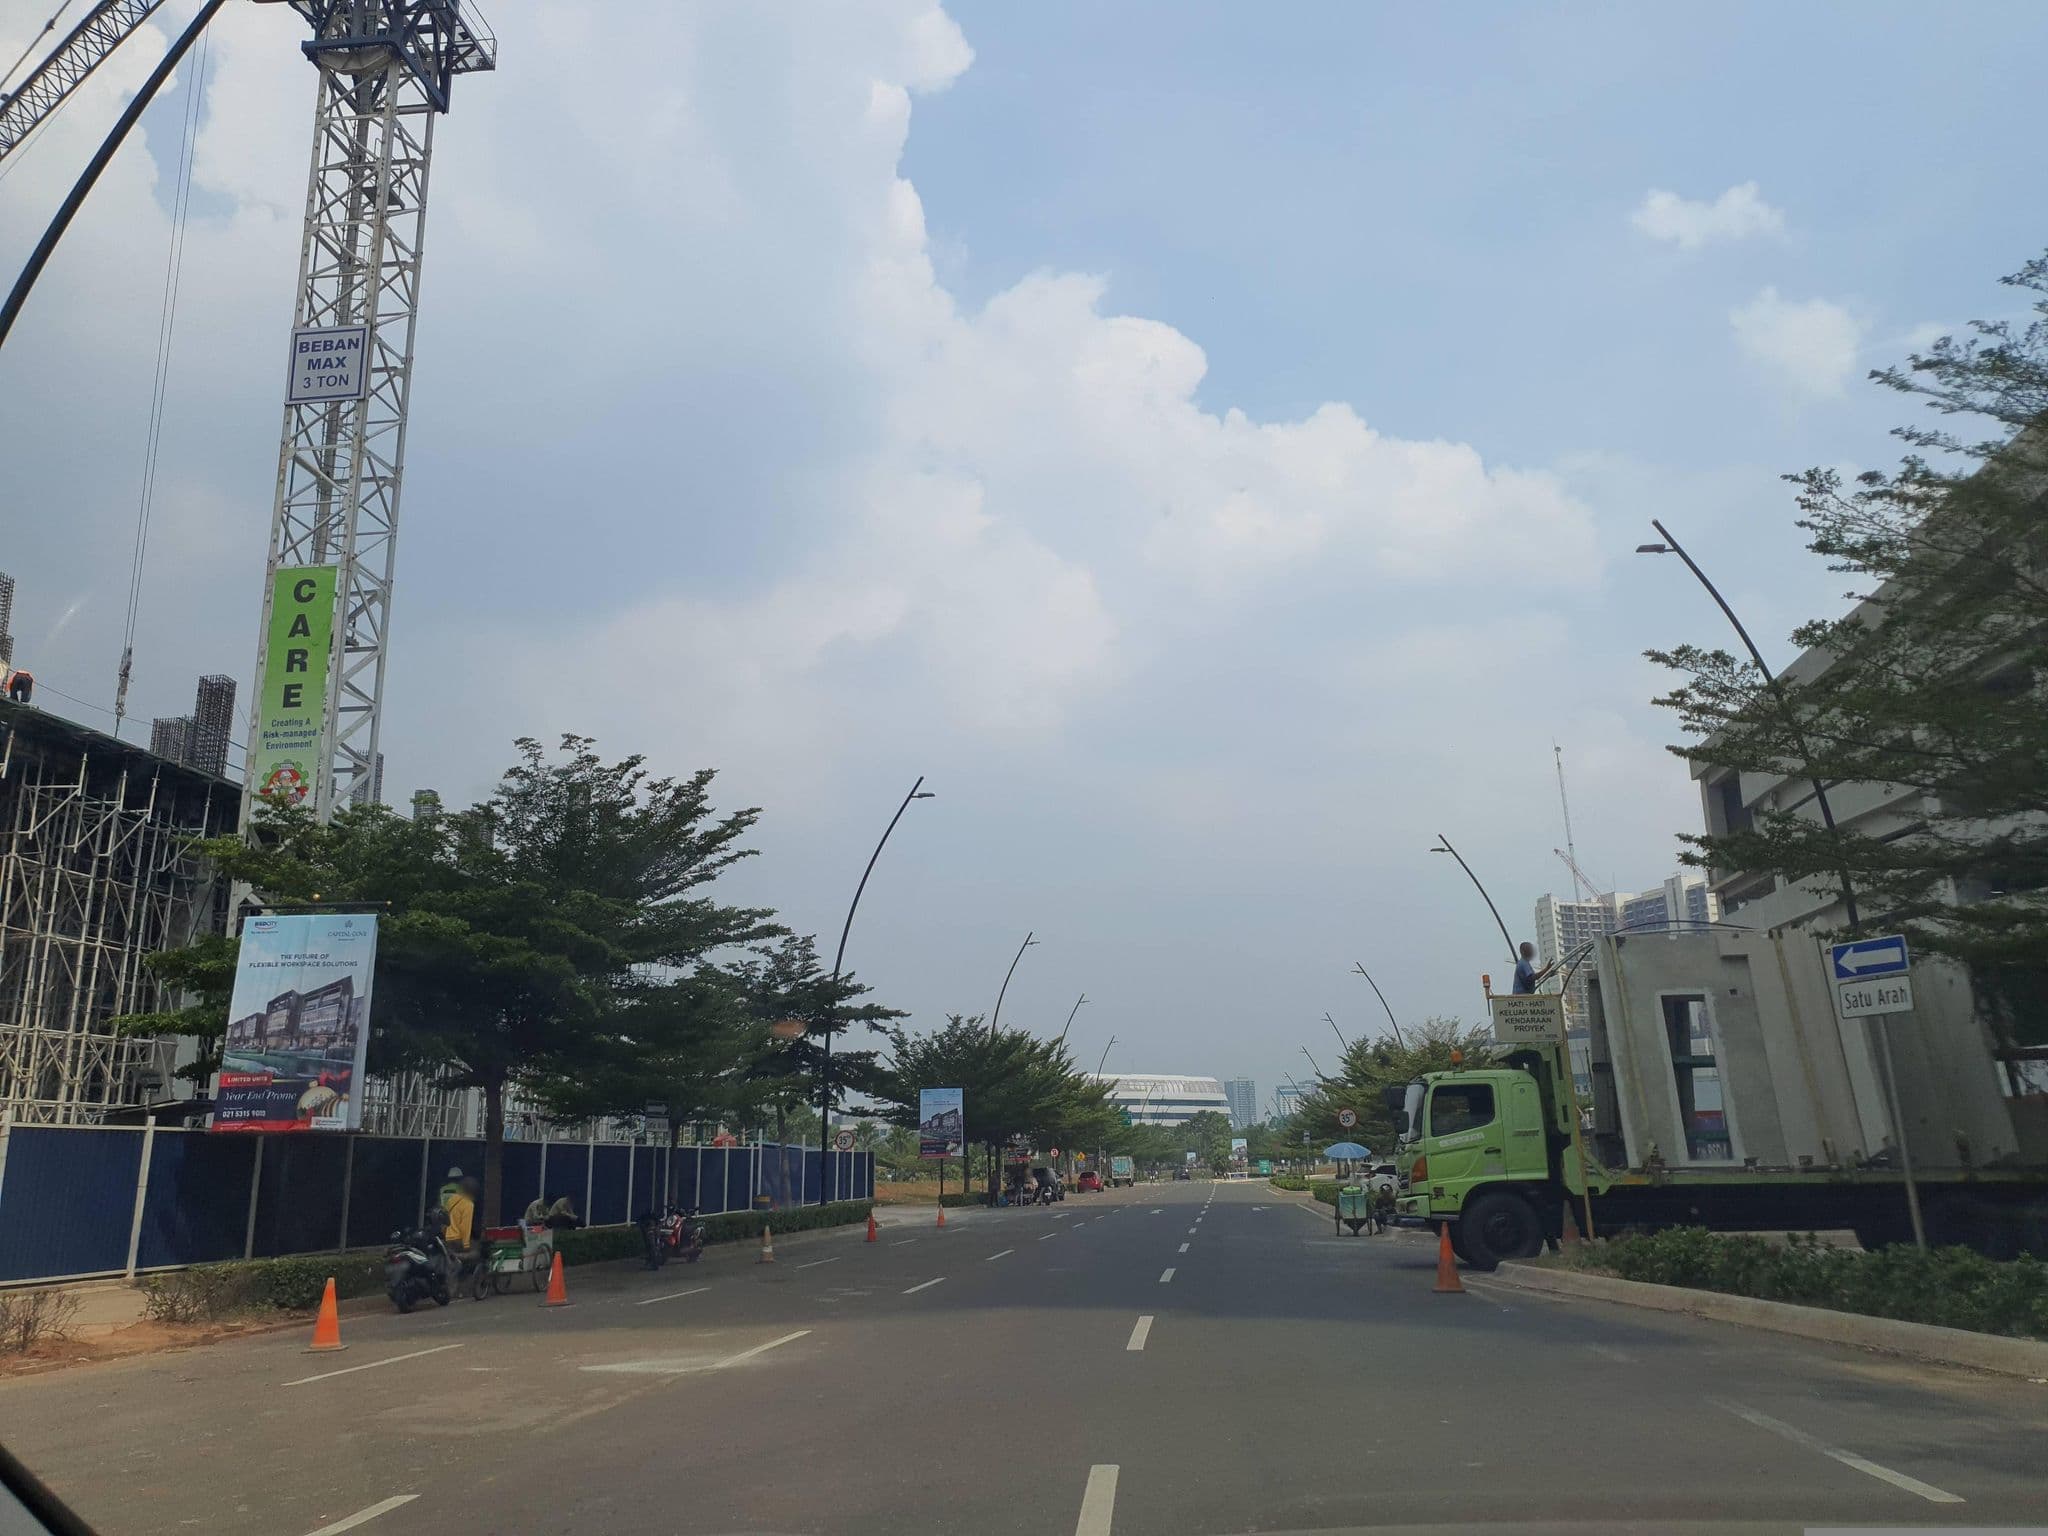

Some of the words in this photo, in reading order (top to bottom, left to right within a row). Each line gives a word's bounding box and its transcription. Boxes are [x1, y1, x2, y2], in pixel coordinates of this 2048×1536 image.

[299, 338, 360, 353] BEBAN
[307, 356, 347, 370] MAX
[303, 377, 311, 388] 3
[317, 374, 349, 388] TON
[282, 579, 317, 709] CARE
[271, 718, 304, 728] Creating
[263, 728, 317, 739] Risk-managed
[266, 740, 313, 750] Environment
[1844, 991, 1873, 1010] Satu
[1878, 986, 1909, 1006] Arah
[1529, 1008, 1556, 1016] MASUK
[225, 1091, 246, 1101] Year
[247, 1090, 266, 1100] End
[266, 1089, 297, 1101] Promo
[222, 1110, 234, 1118] 021
